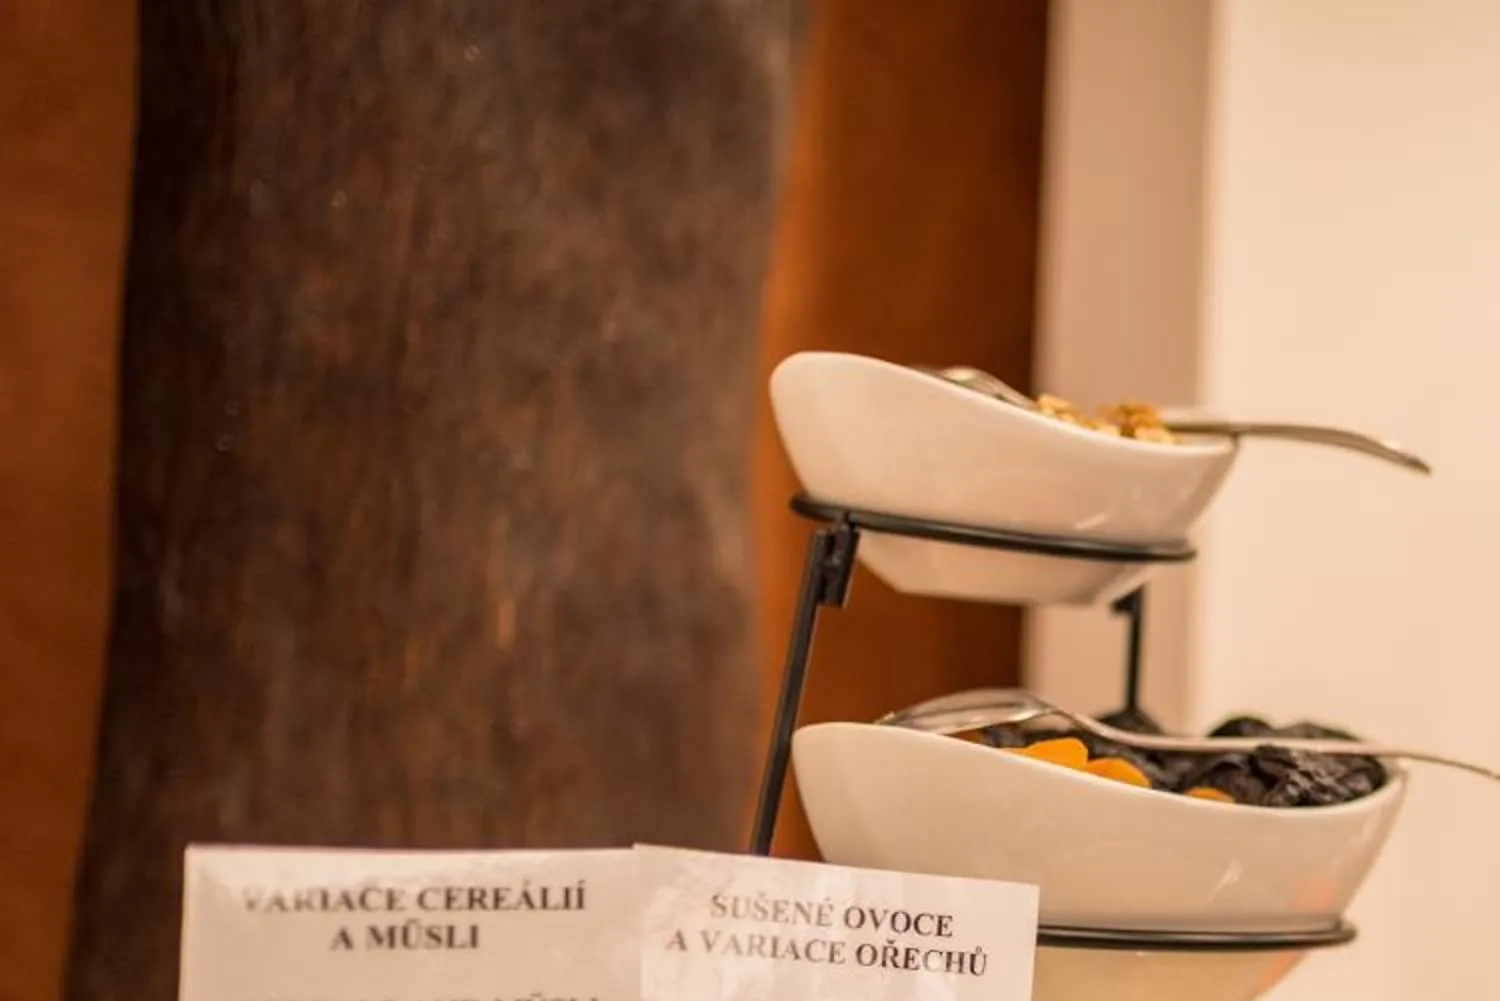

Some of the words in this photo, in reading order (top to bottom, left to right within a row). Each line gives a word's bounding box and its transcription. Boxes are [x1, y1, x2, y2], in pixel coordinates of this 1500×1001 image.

[416, 879, 586, 912] CEREÁLIÍ
[710, 892, 833, 927] SUŠENÉ
[844, 906, 953, 937] OVOCE
[328, 926, 353, 950] A
[666, 929, 688, 952] A
[700, 930, 847, 965] VARIACE
[855, 939, 987, 976] OŘECHŮ
